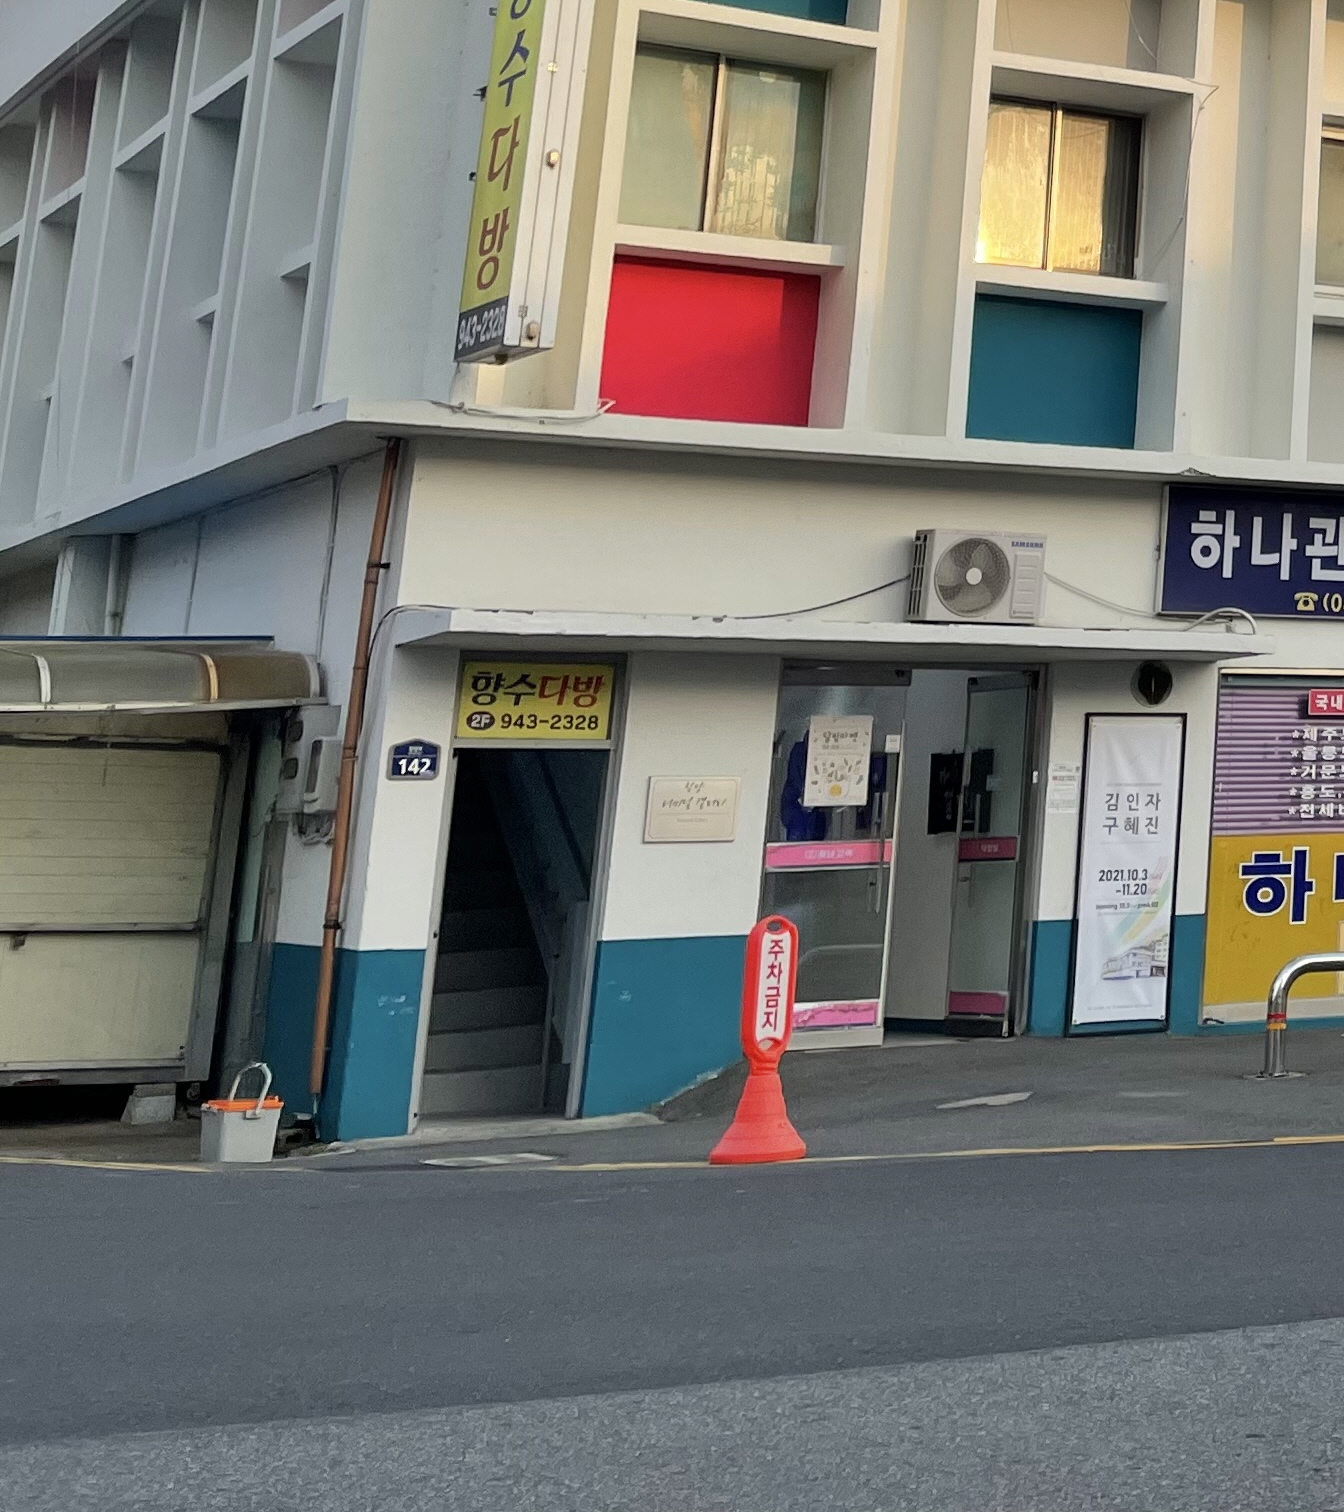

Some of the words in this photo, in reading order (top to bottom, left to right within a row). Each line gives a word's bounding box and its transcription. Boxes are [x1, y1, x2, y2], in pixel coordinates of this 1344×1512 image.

[458, 305, 506, 350] 943-2328
[471, 671, 605, 708] 향수다방
[470, 714, 491, 729] 2F
[500, 714, 599, 731] 943-2328
[398, 758, 432, 776] 142
[1098, 869, 1149, 883] 2021.10.3
[762, 939, 785, 1032] 주차금지
